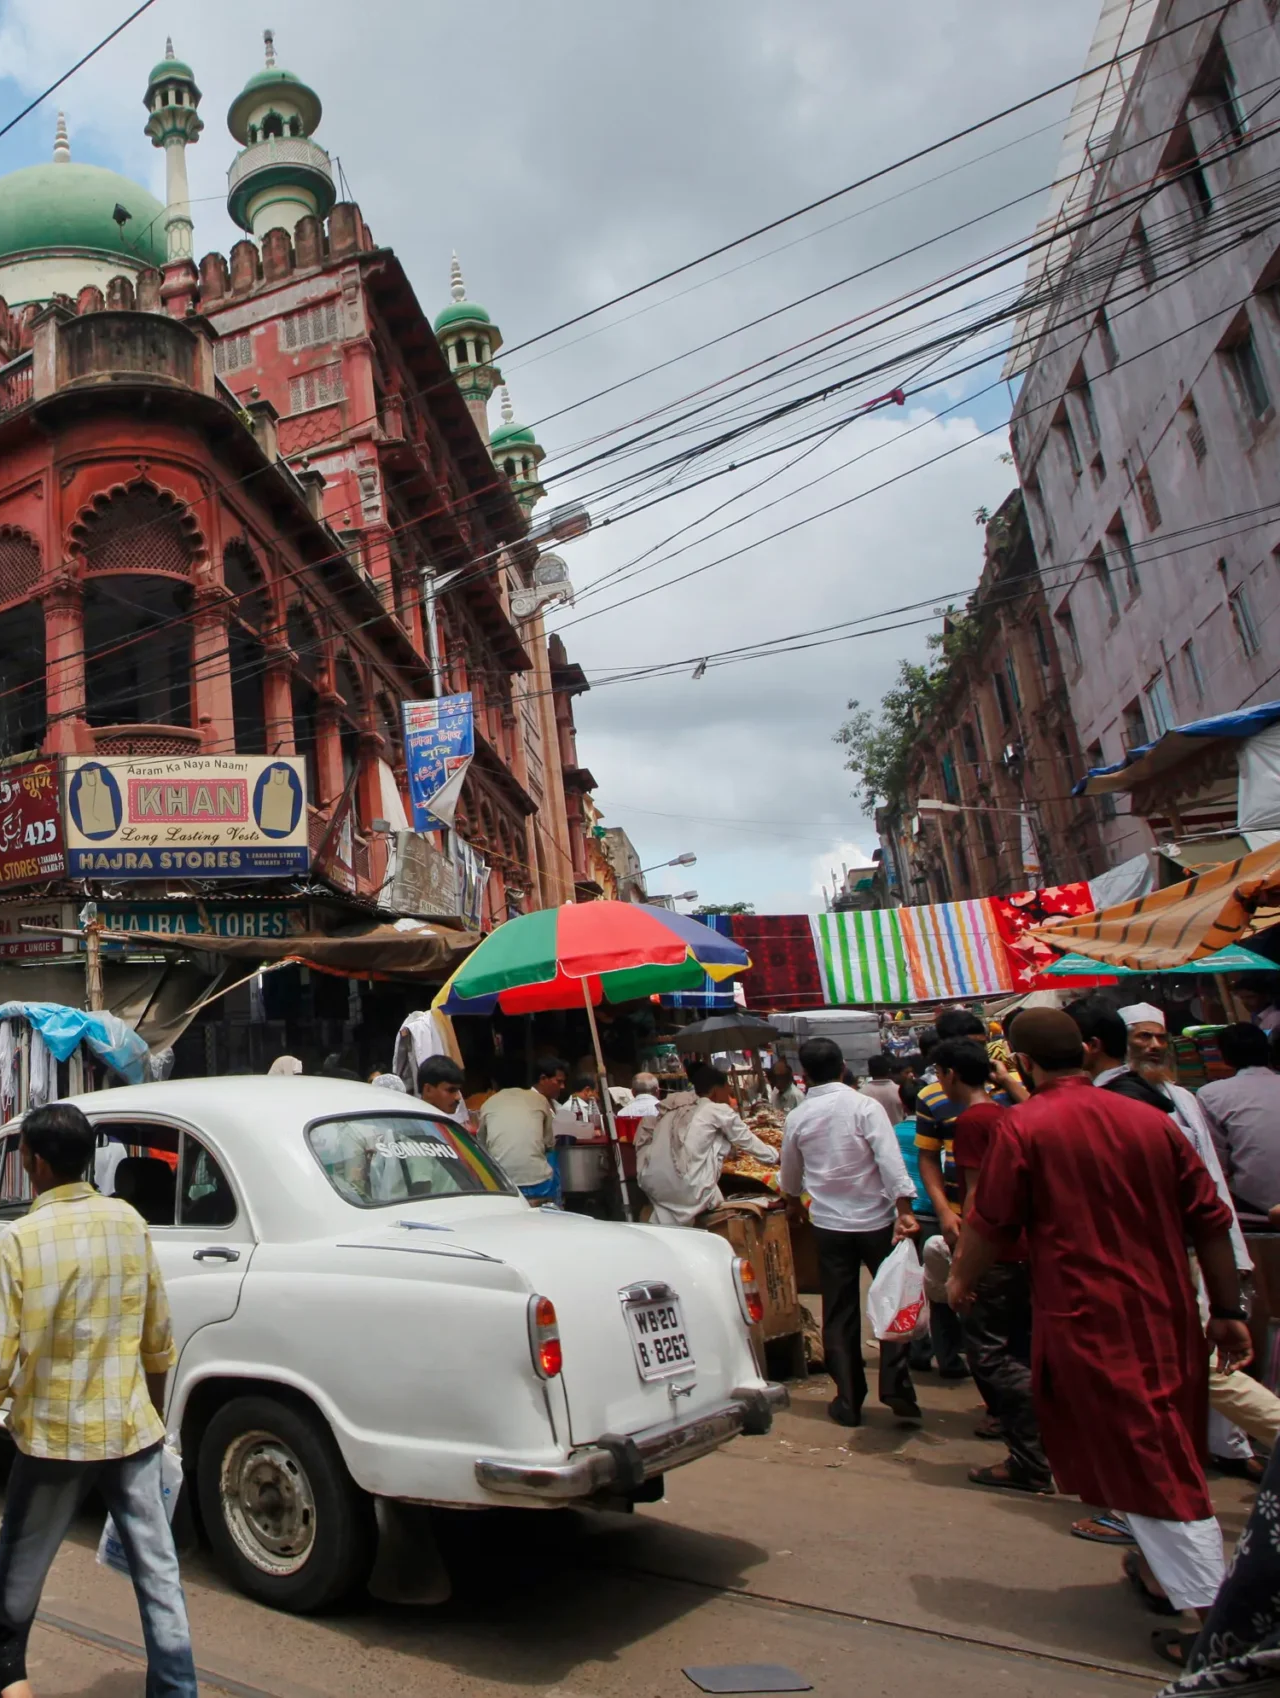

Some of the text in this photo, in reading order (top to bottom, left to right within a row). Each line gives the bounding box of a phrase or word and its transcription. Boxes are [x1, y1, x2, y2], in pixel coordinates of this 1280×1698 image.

[127, 760, 248, 775] Aaram Ka Naya Naam!
[137, 785, 241, 817] KHAN
[24, 818, 57, 846] 425
[120, 827, 260, 846] Long Lasting Vests
[3, 858, 39, 881] STORES
[79, 851, 241, 870] HAJRA STORES
[9, 944, 20, 954] OF
[24, 941, 56, 953] LUNGIES
[375, 1141, 458, 1159] S@MISHU
